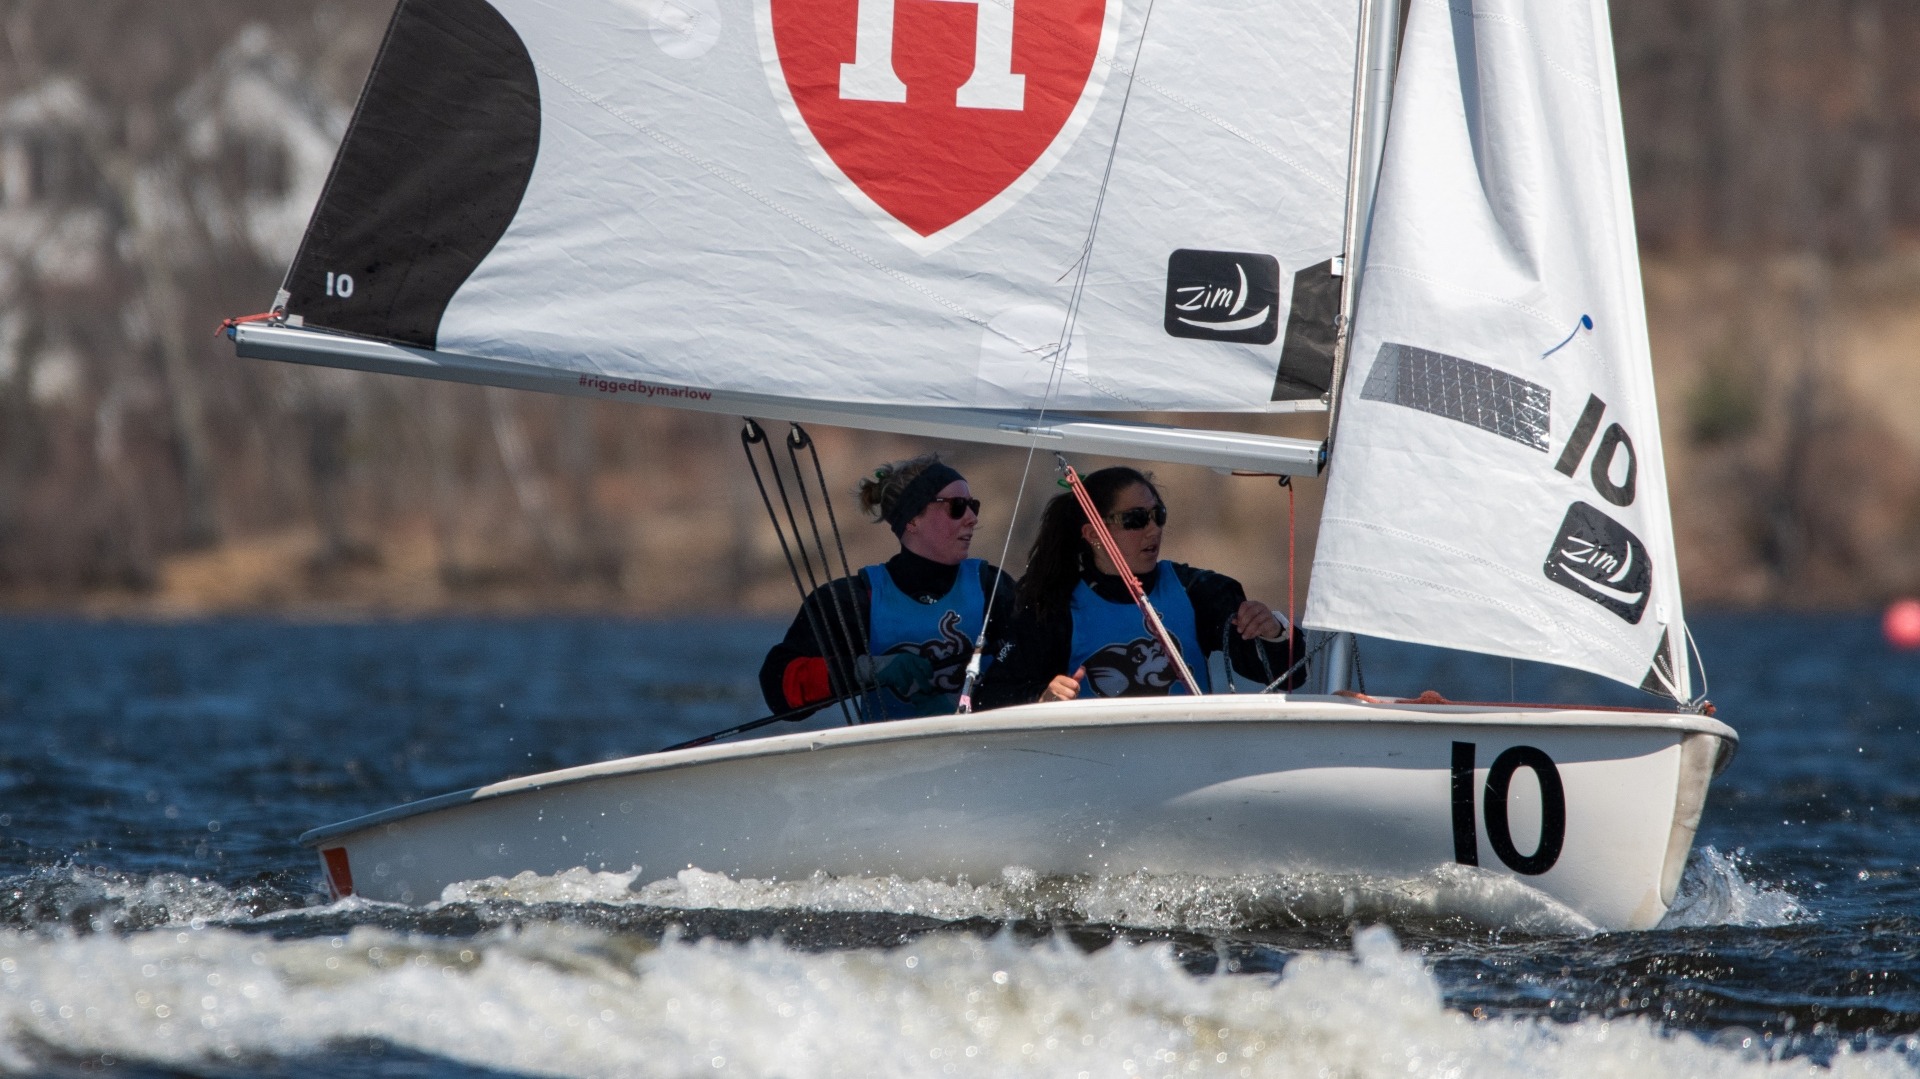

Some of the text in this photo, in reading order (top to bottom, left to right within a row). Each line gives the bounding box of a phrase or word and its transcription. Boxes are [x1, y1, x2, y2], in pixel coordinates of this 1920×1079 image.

[326, 271, 354, 298] 10
[579, 374, 712, 400] #riggedbymarlow
[1554, 393, 1637, 507] 10
[1451, 741, 1566, 876] 10
